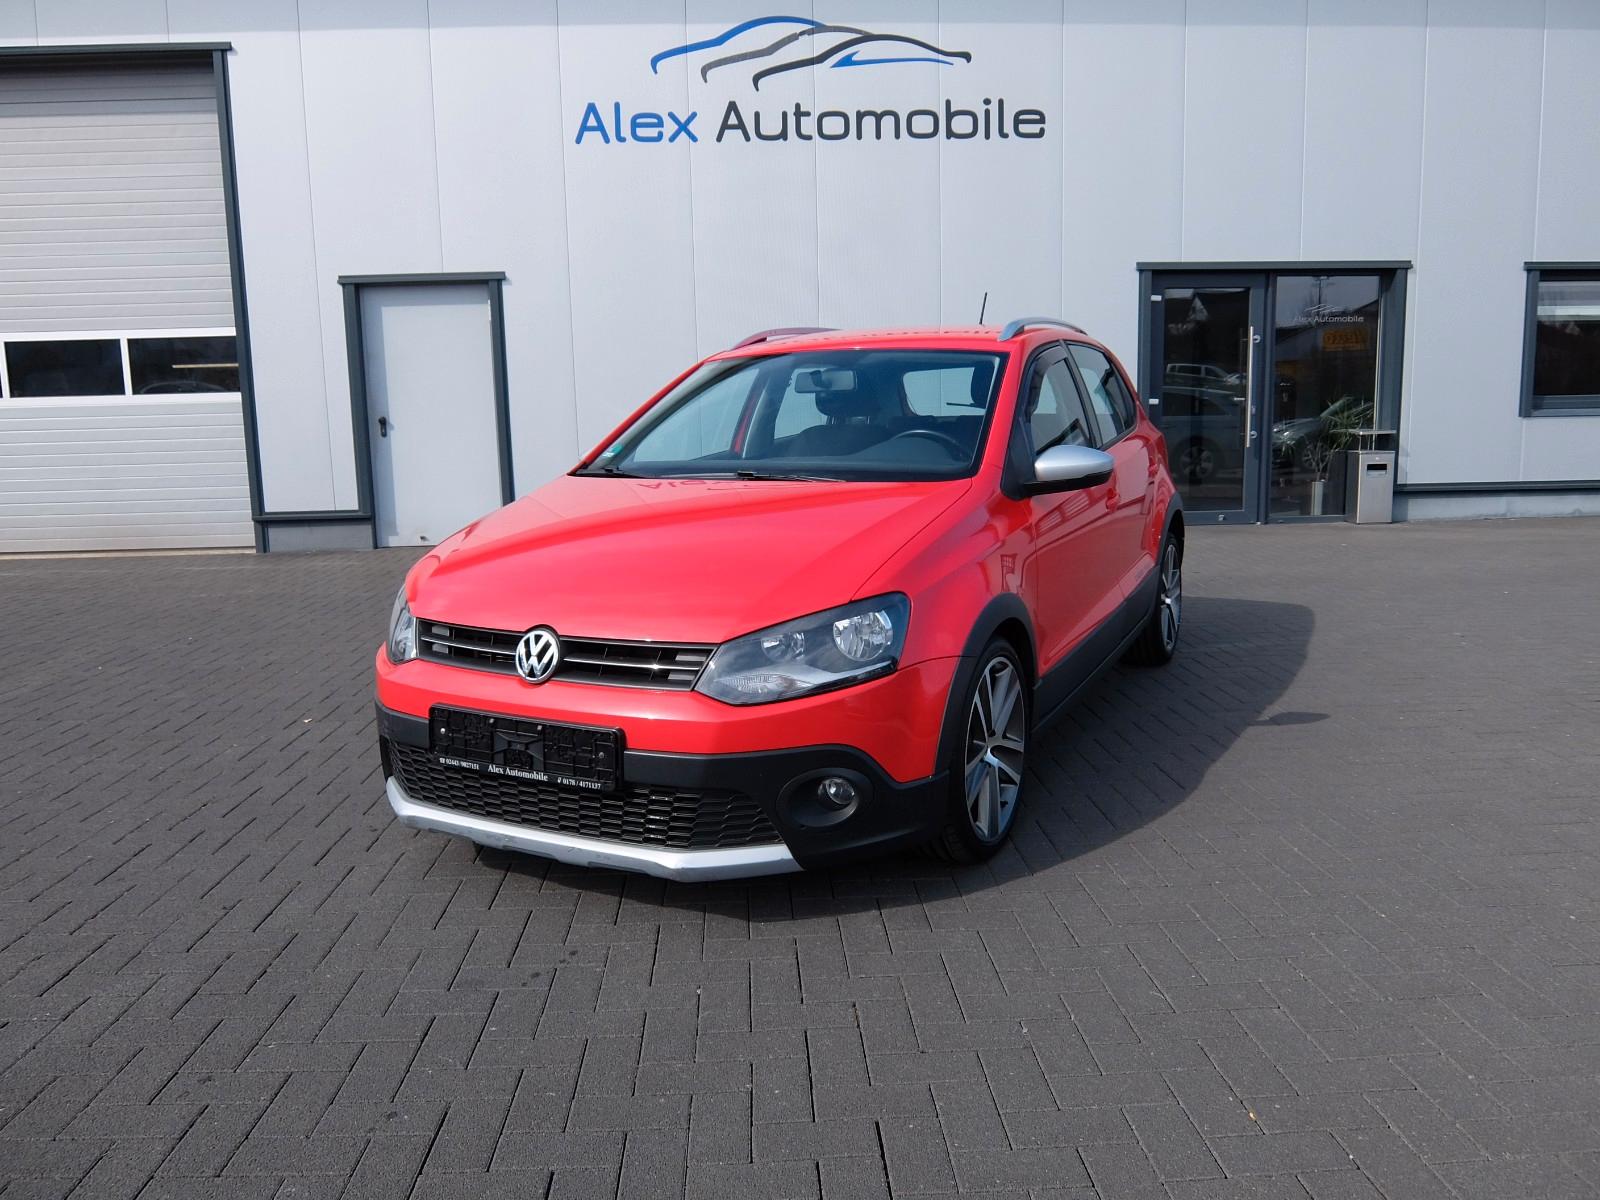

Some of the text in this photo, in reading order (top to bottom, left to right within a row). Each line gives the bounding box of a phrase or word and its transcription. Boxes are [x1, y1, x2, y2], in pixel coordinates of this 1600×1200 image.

[575, 98, 1046, 144] Alex Automobile
[1313, 314, 1364, 323] Automobile
[487, 764, 549, 781] Alex Automobile
